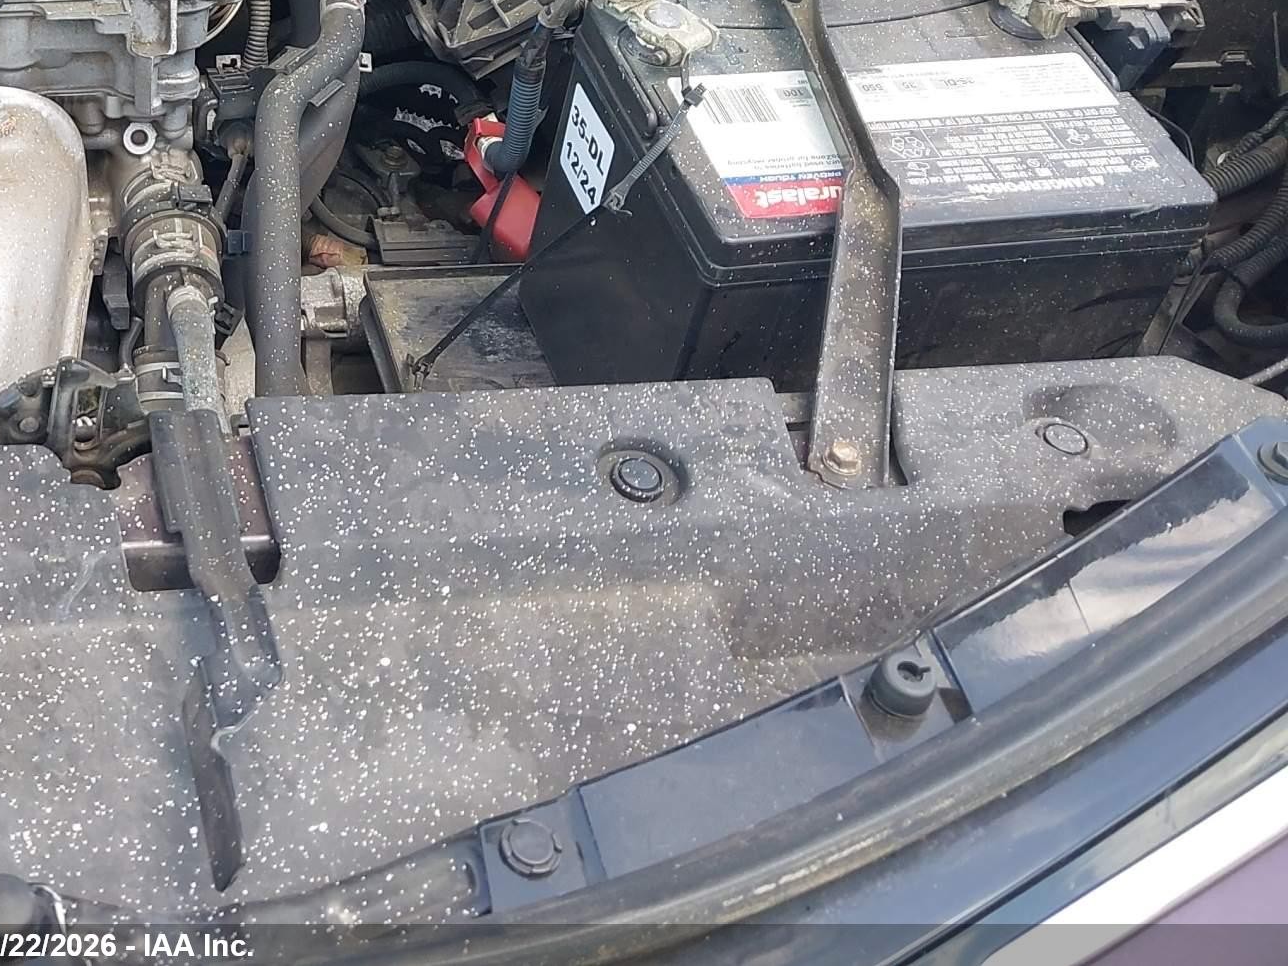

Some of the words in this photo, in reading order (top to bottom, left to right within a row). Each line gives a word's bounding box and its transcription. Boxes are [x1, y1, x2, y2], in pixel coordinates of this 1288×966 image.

[571, 105, 604, 176] 35-DL
[566, 141, 597, 205] 12/24
[760, 173, 796, 182] TOUGH
[797, 171, 842, 180] PROVEN
